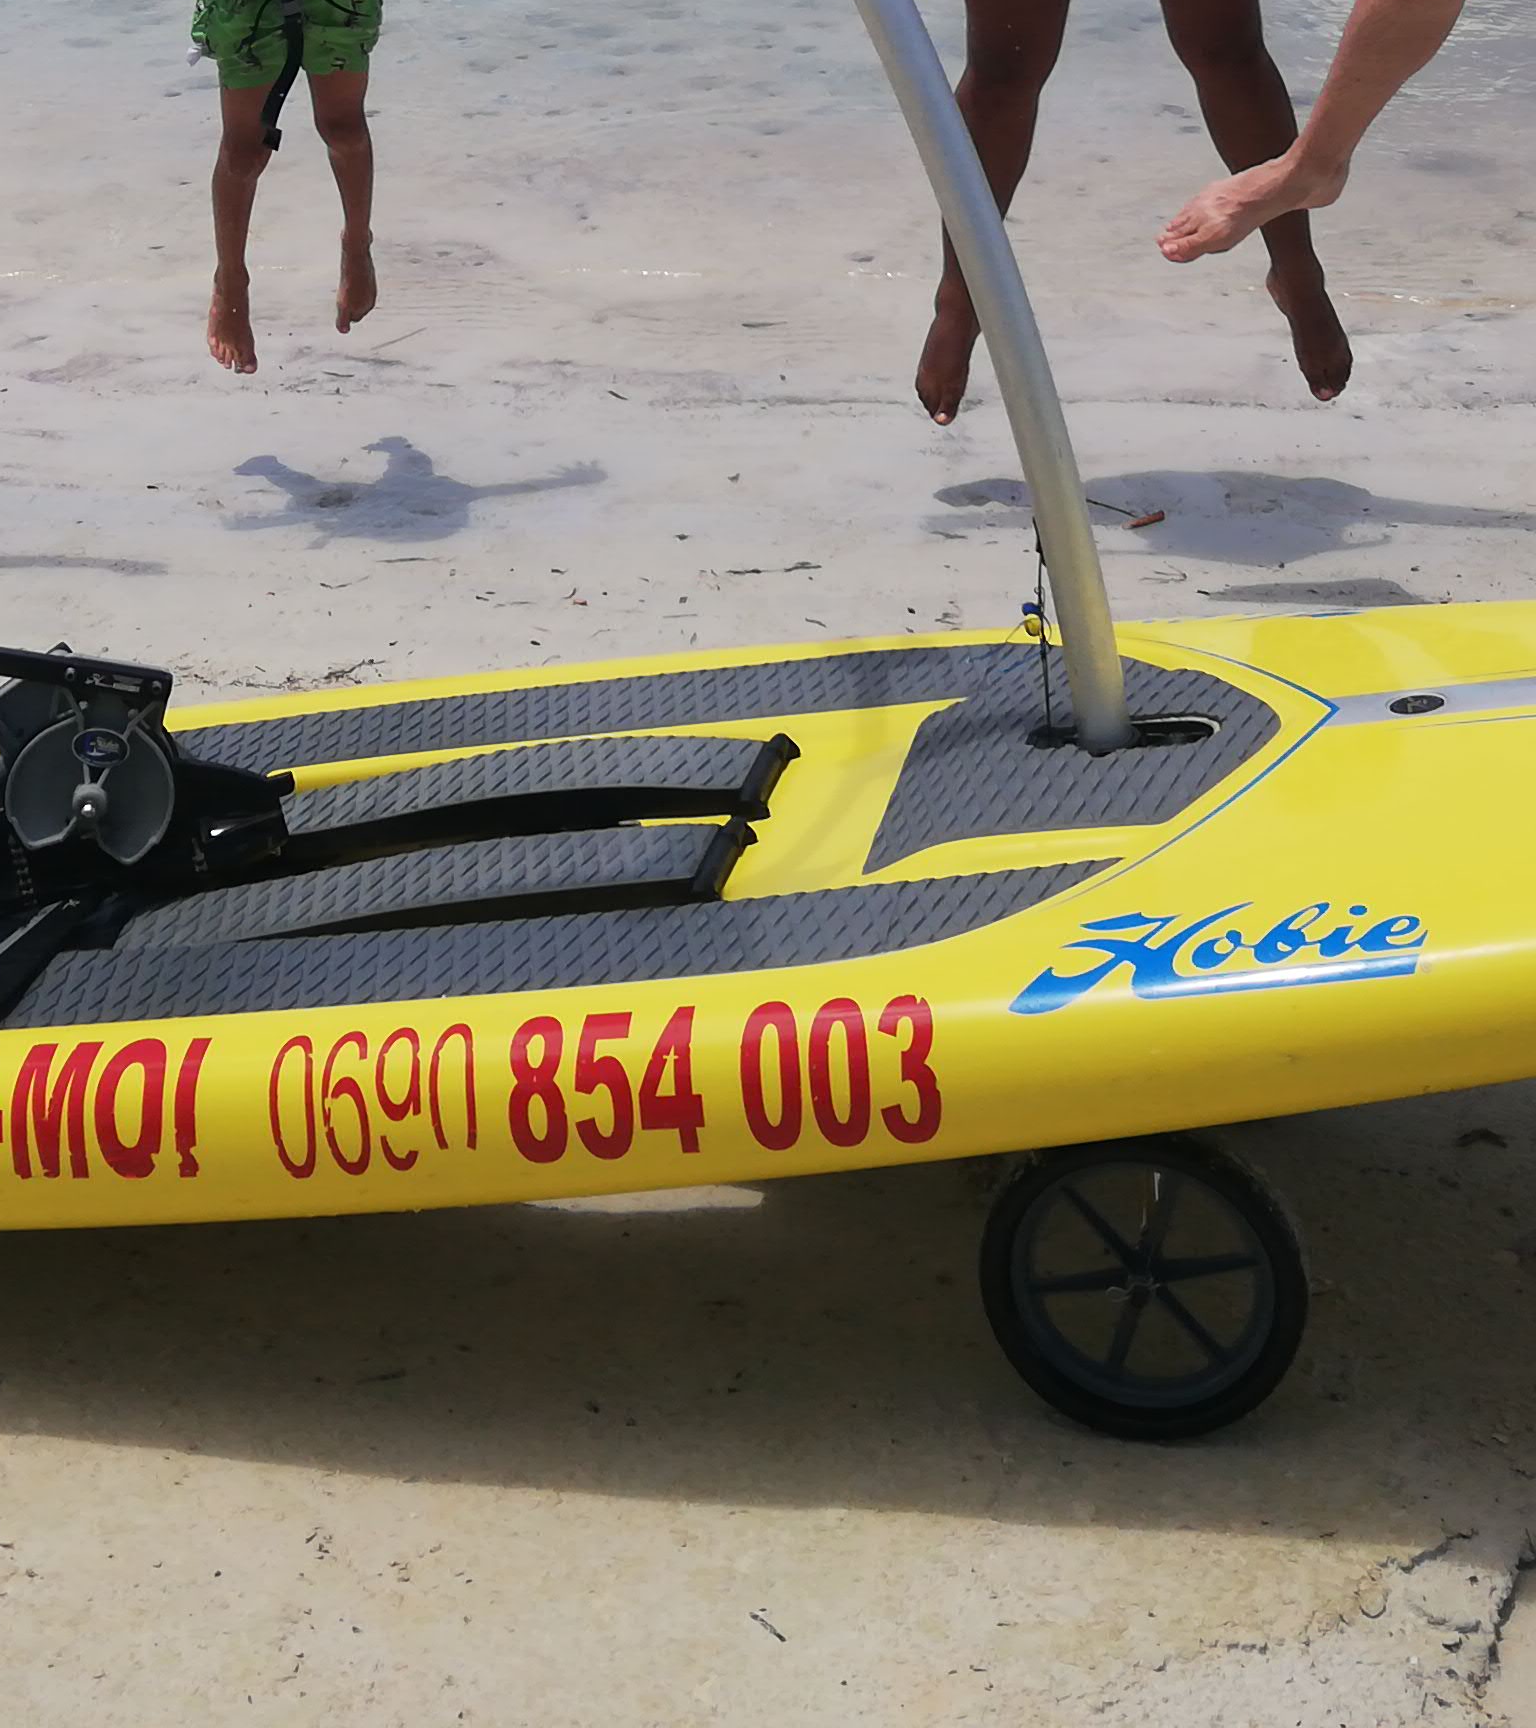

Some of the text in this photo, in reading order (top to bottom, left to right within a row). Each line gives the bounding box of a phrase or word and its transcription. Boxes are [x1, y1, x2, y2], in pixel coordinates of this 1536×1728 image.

[1007, 901, 1428, 1015] Hobie
[268, 1023, 478, 1180] 0690
[507, 1005, 706, 1164] 854
[739, 994, 944, 1152] 003
